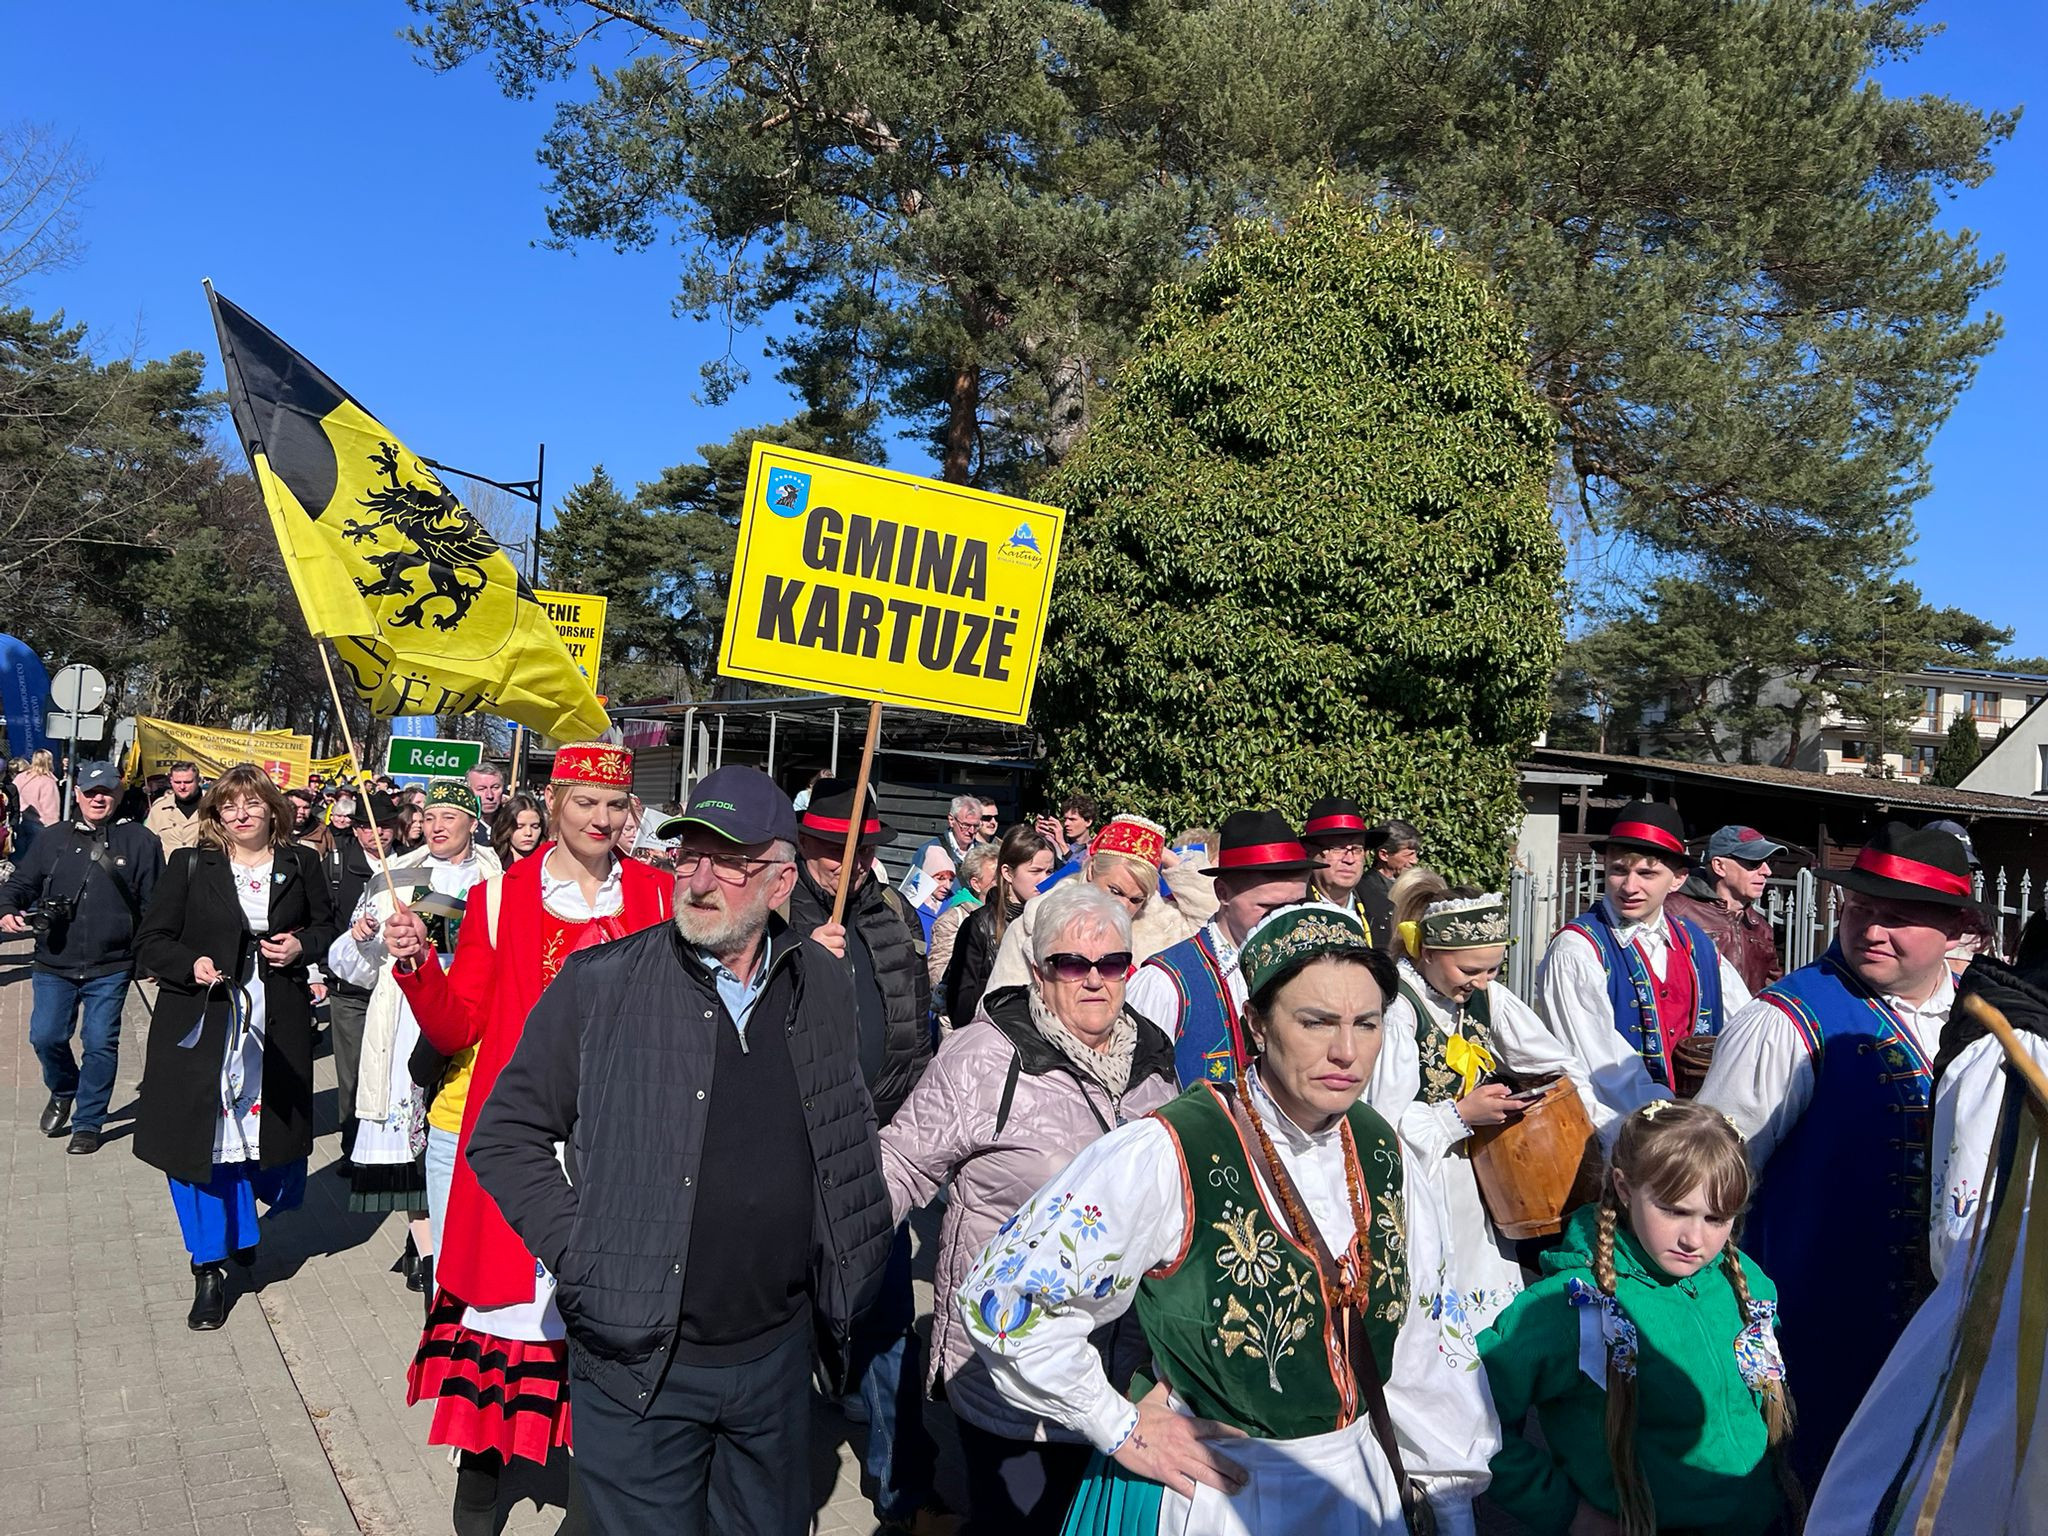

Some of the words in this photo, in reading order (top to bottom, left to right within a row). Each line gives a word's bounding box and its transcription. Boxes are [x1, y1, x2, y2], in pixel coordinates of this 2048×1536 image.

[802, 507, 987, 601] GMINA
[757, 575, 1020, 682] KARTUZË
[410, 748, 460, 768] Réda
[694, 800, 737, 811] FESTOOL
